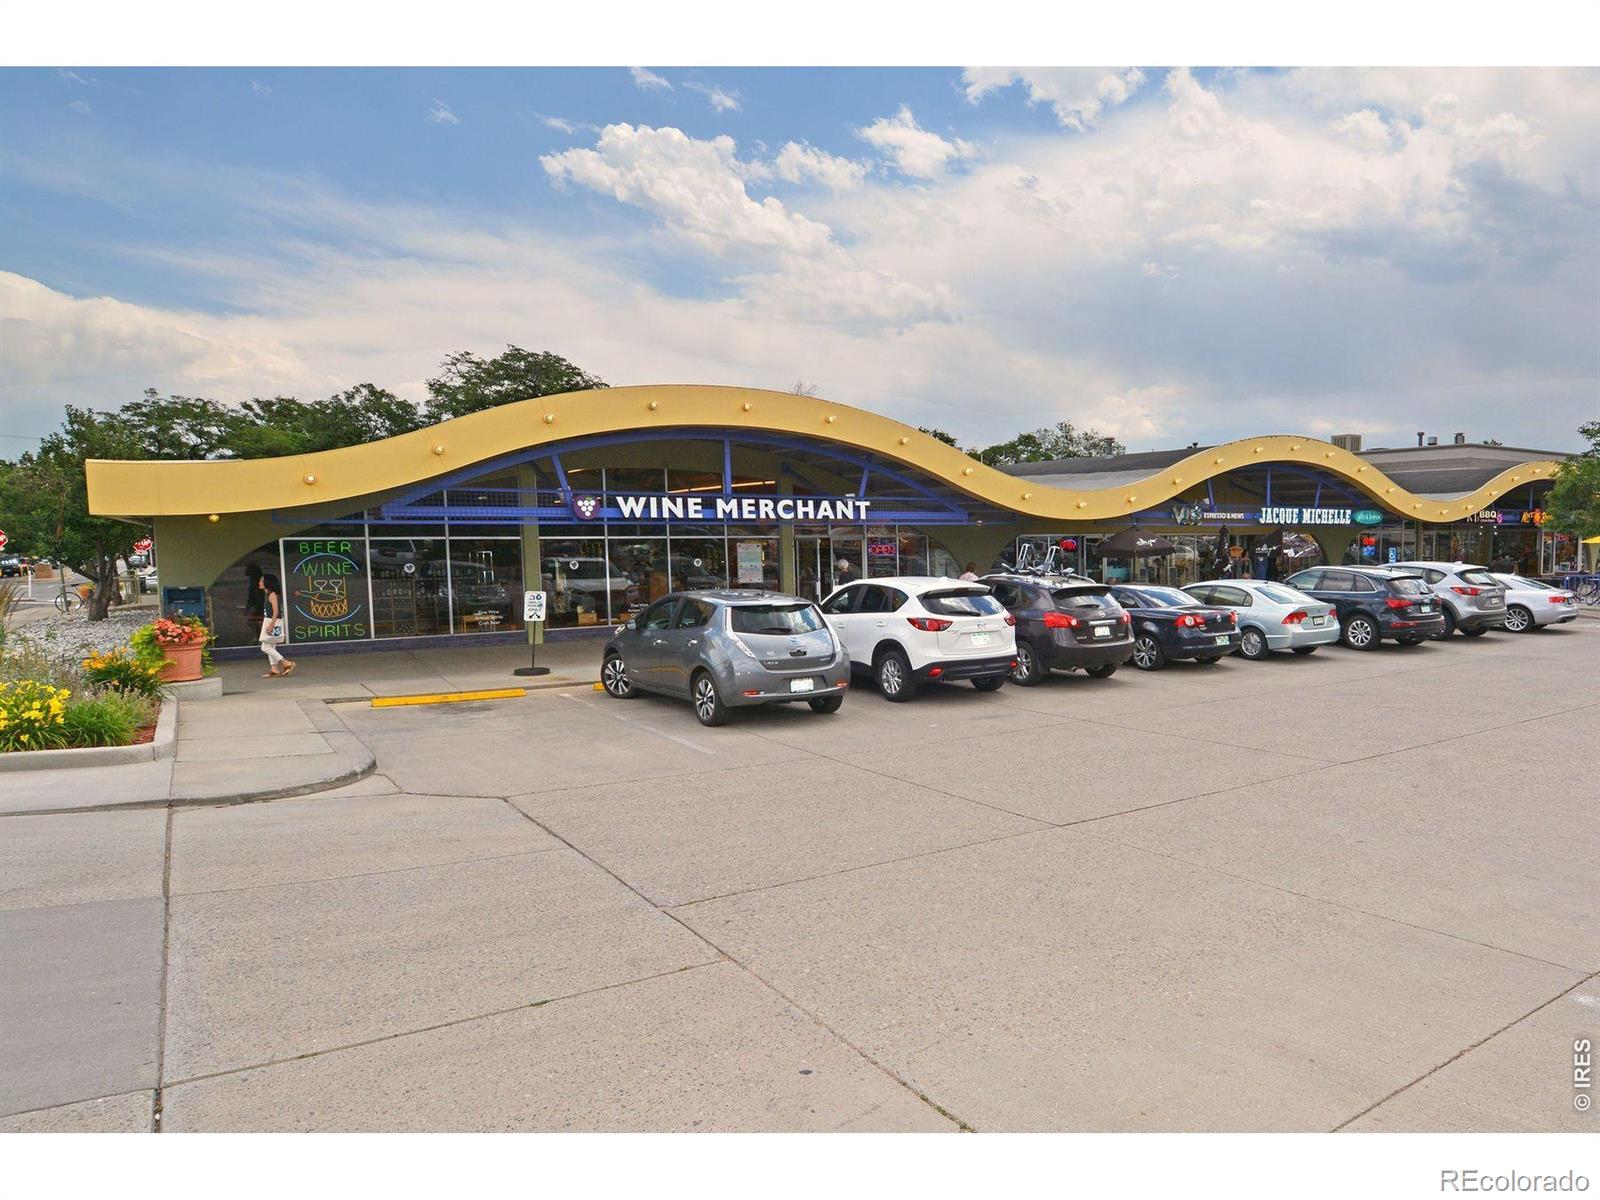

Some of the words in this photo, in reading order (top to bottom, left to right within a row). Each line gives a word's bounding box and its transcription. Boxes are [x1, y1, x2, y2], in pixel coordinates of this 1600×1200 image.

[616, 496, 703, 519] WINE
[716, 498, 870, 520] MERCHANT
[1480, 510, 1497, 519] BBQ
[1302, 508, 1352, 525] MICHELLE
[299, 541, 352, 554] BEER
[869, 544, 897, 555] OPEN
[302, 561, 353, 577] WINE
[294, 623, 365, 640] SPIRITS
